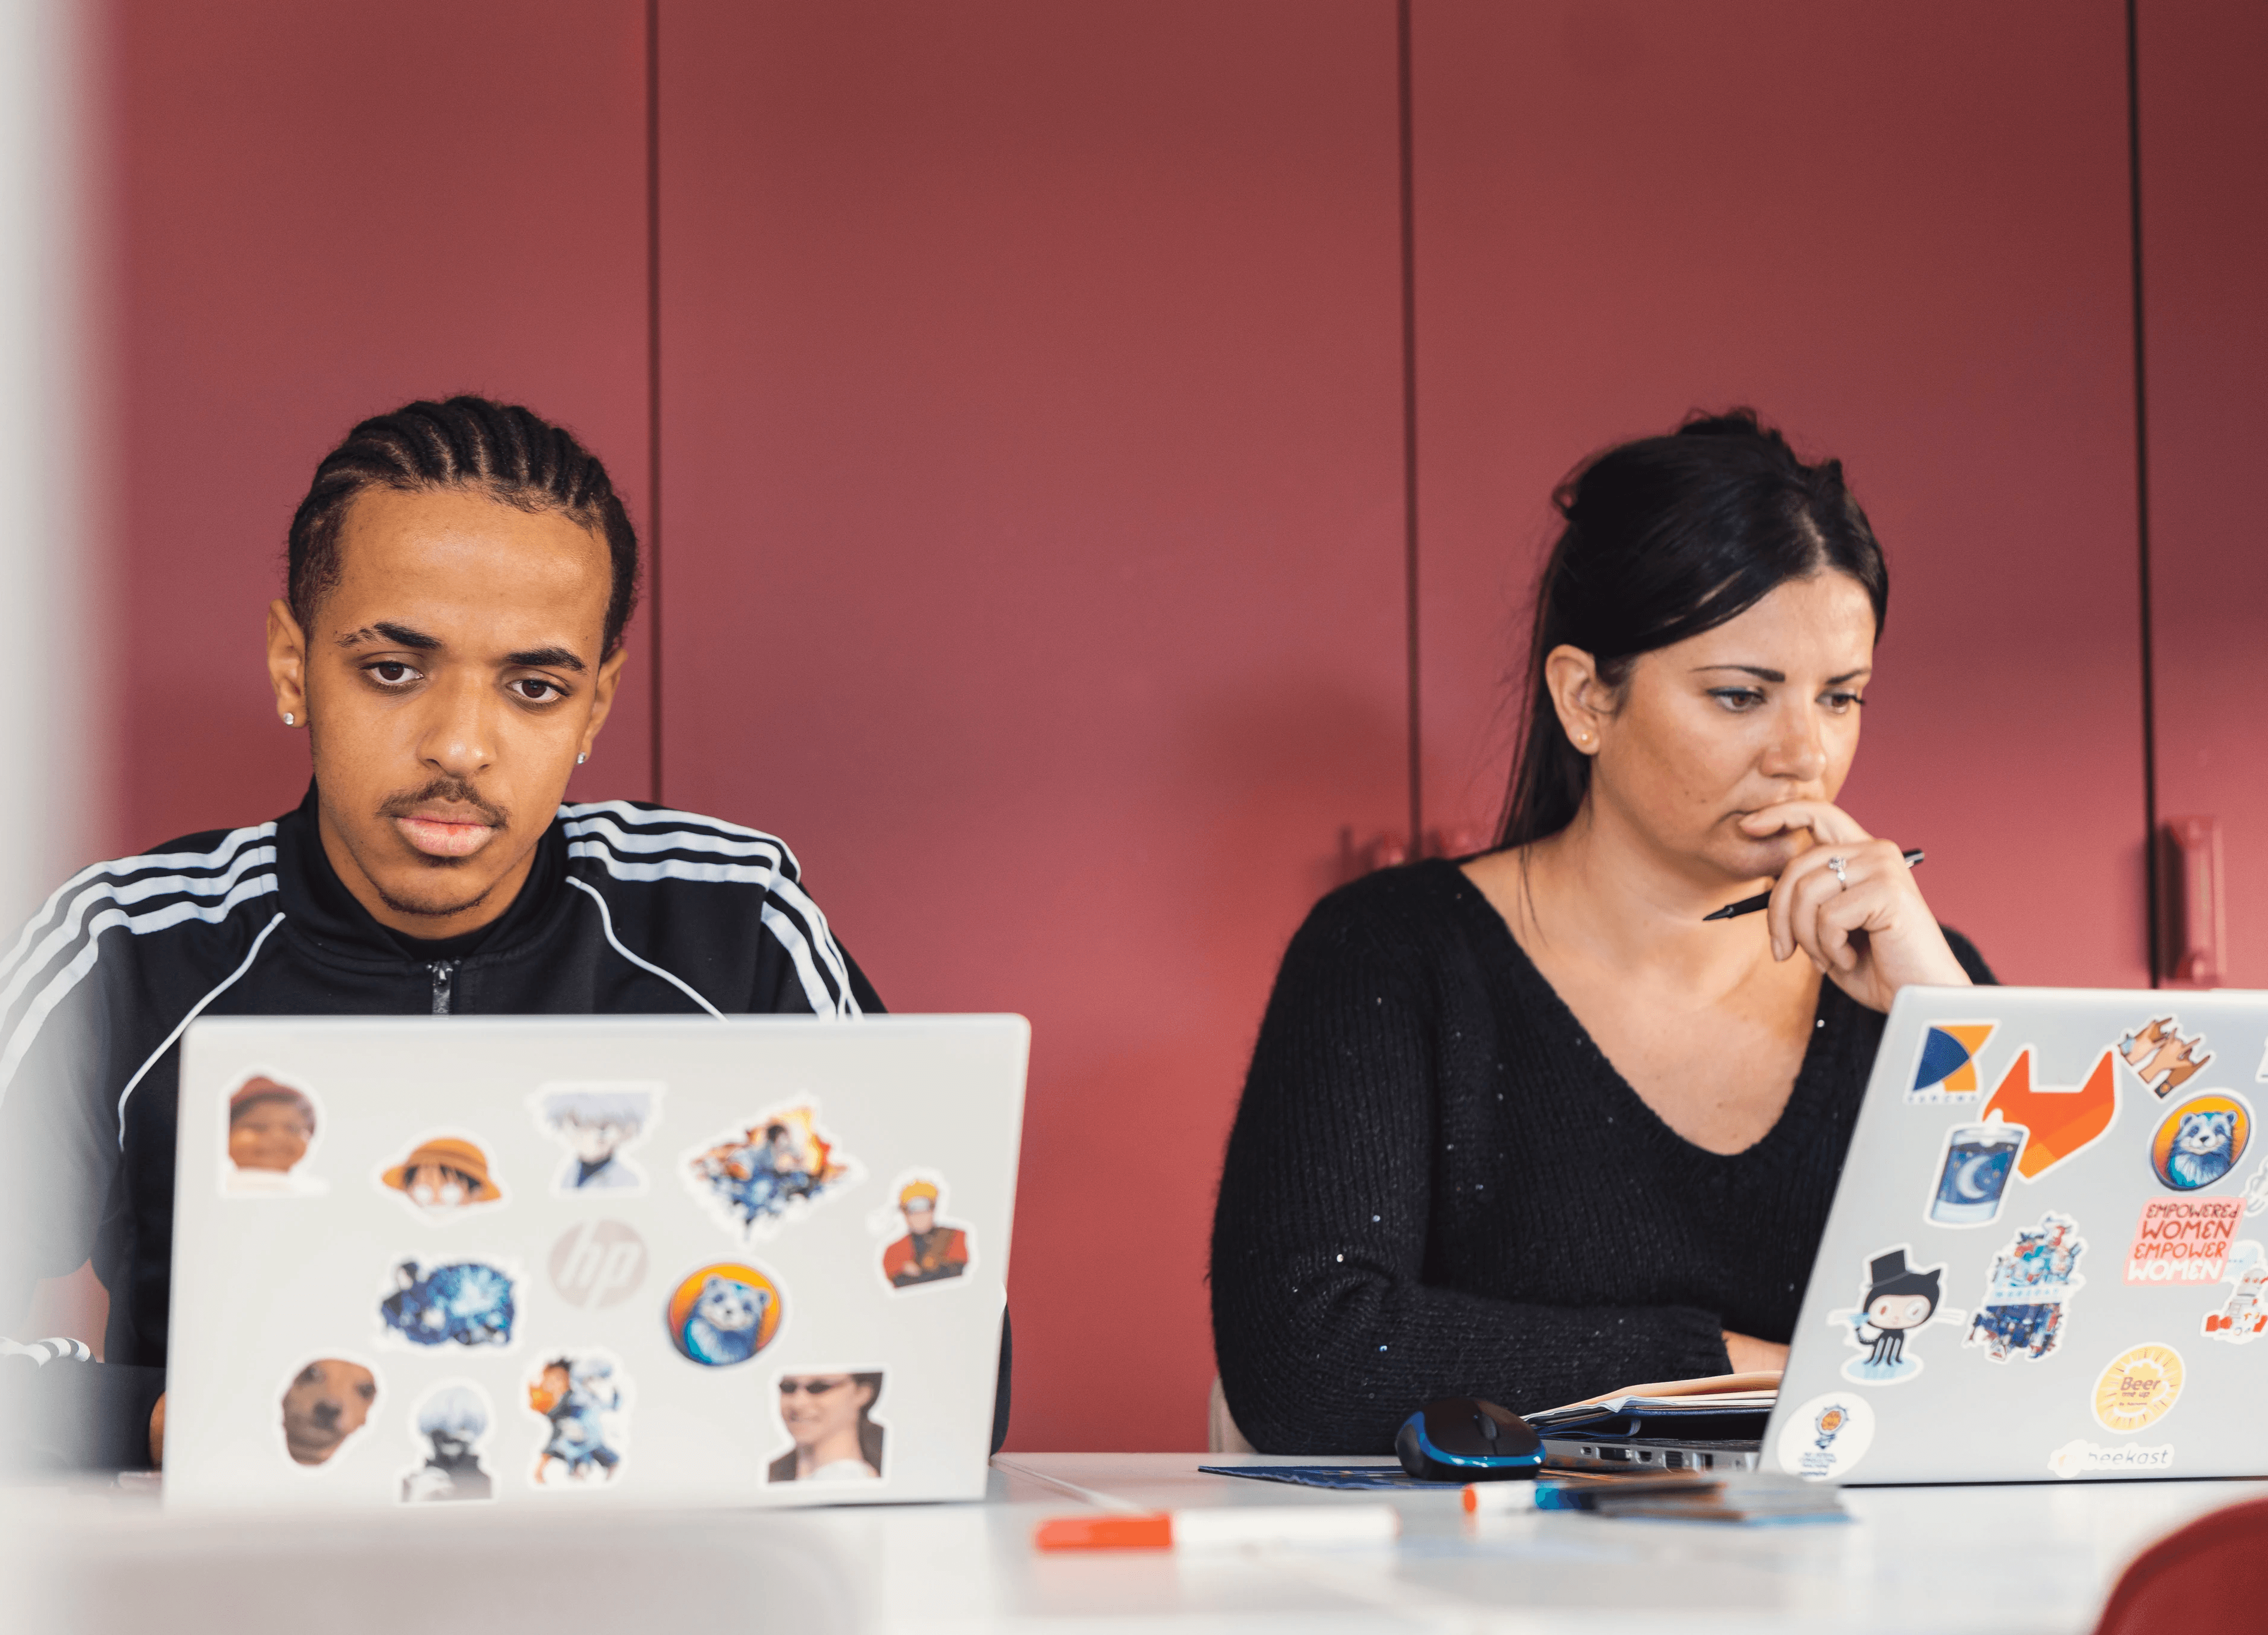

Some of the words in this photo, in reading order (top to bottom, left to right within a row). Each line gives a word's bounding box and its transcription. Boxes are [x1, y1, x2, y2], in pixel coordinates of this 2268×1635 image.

[2142, 1220, 2234, 1239] WOMEN
[2134, 1241, 2227, 1259] EMPOWER
[556, 1219, 642, 1309] hp
[2127, 1259, 2223, 1281] WOMEN
[2120, 1376, 2161, 1391] Beer
